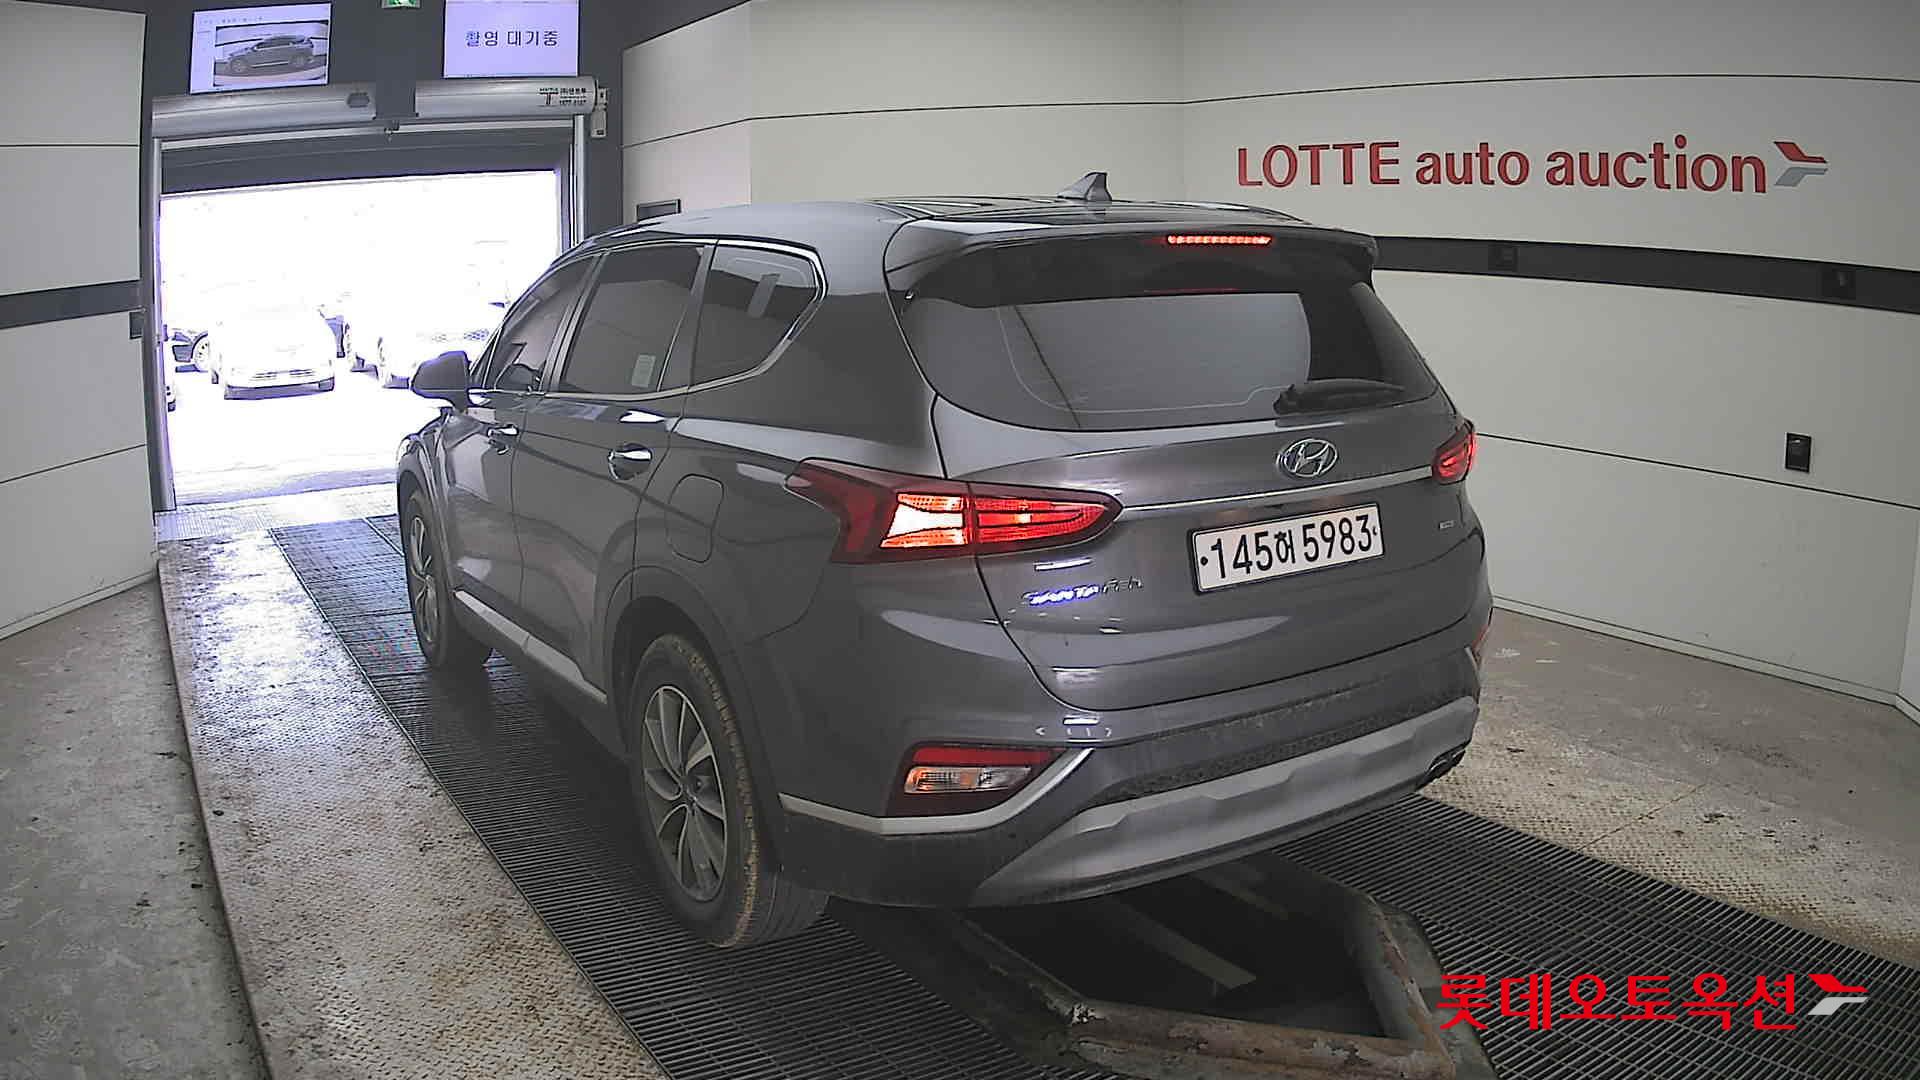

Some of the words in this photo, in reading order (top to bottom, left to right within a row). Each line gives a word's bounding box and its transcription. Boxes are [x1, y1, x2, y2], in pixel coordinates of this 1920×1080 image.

[465, 30, 499, 47] 촬영
[506, 30, 558, 47] 대기중
[1237, 141, 1400, 188] LOTTE
[1415, 142, 1530, 186] auto
[1546, 134, 1766, 193] auction
[1210, 529, 1296, 579] 145허
[1302, 514, 1372, 562] 5983
